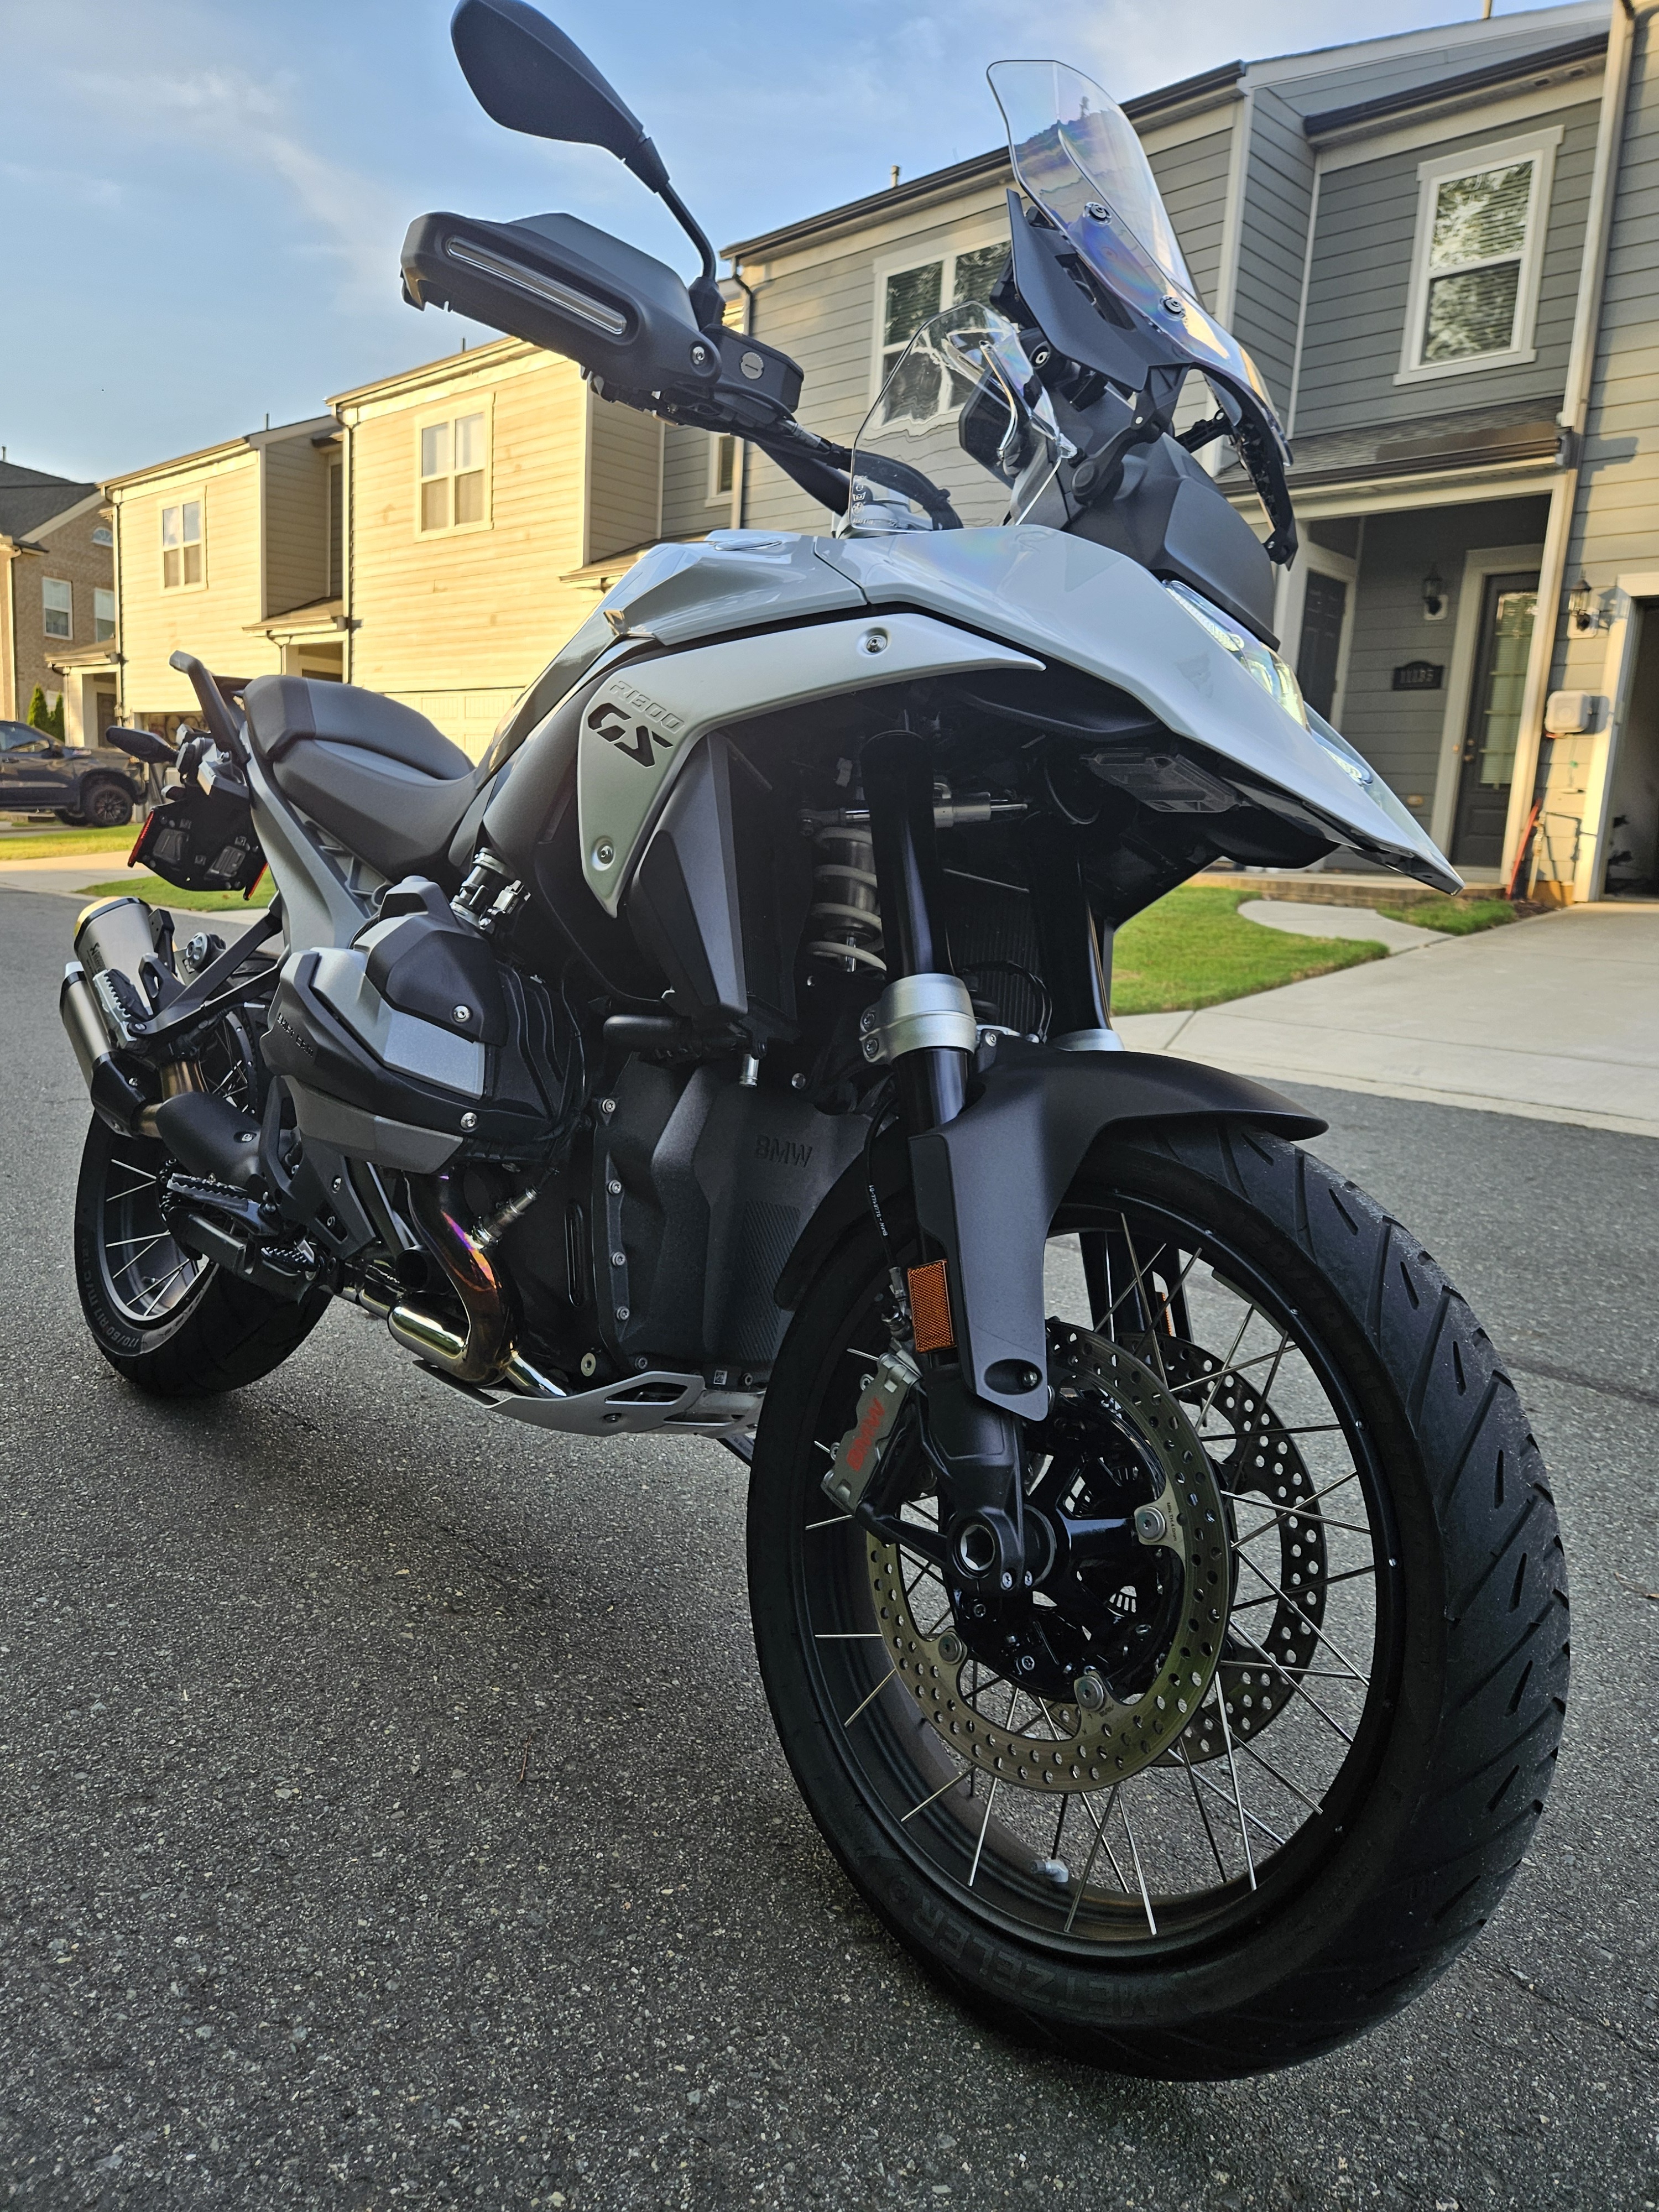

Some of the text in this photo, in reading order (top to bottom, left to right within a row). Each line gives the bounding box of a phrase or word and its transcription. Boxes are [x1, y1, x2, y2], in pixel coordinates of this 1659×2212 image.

[587, 702, 674, 768] GS
[755, 1135, 812, 1168] BMW
[107, 1327, 139, 1348] 170/60
[847, 1396, 885, 1472] BMW
[913, 1896, 1160, 2018] METZELER
